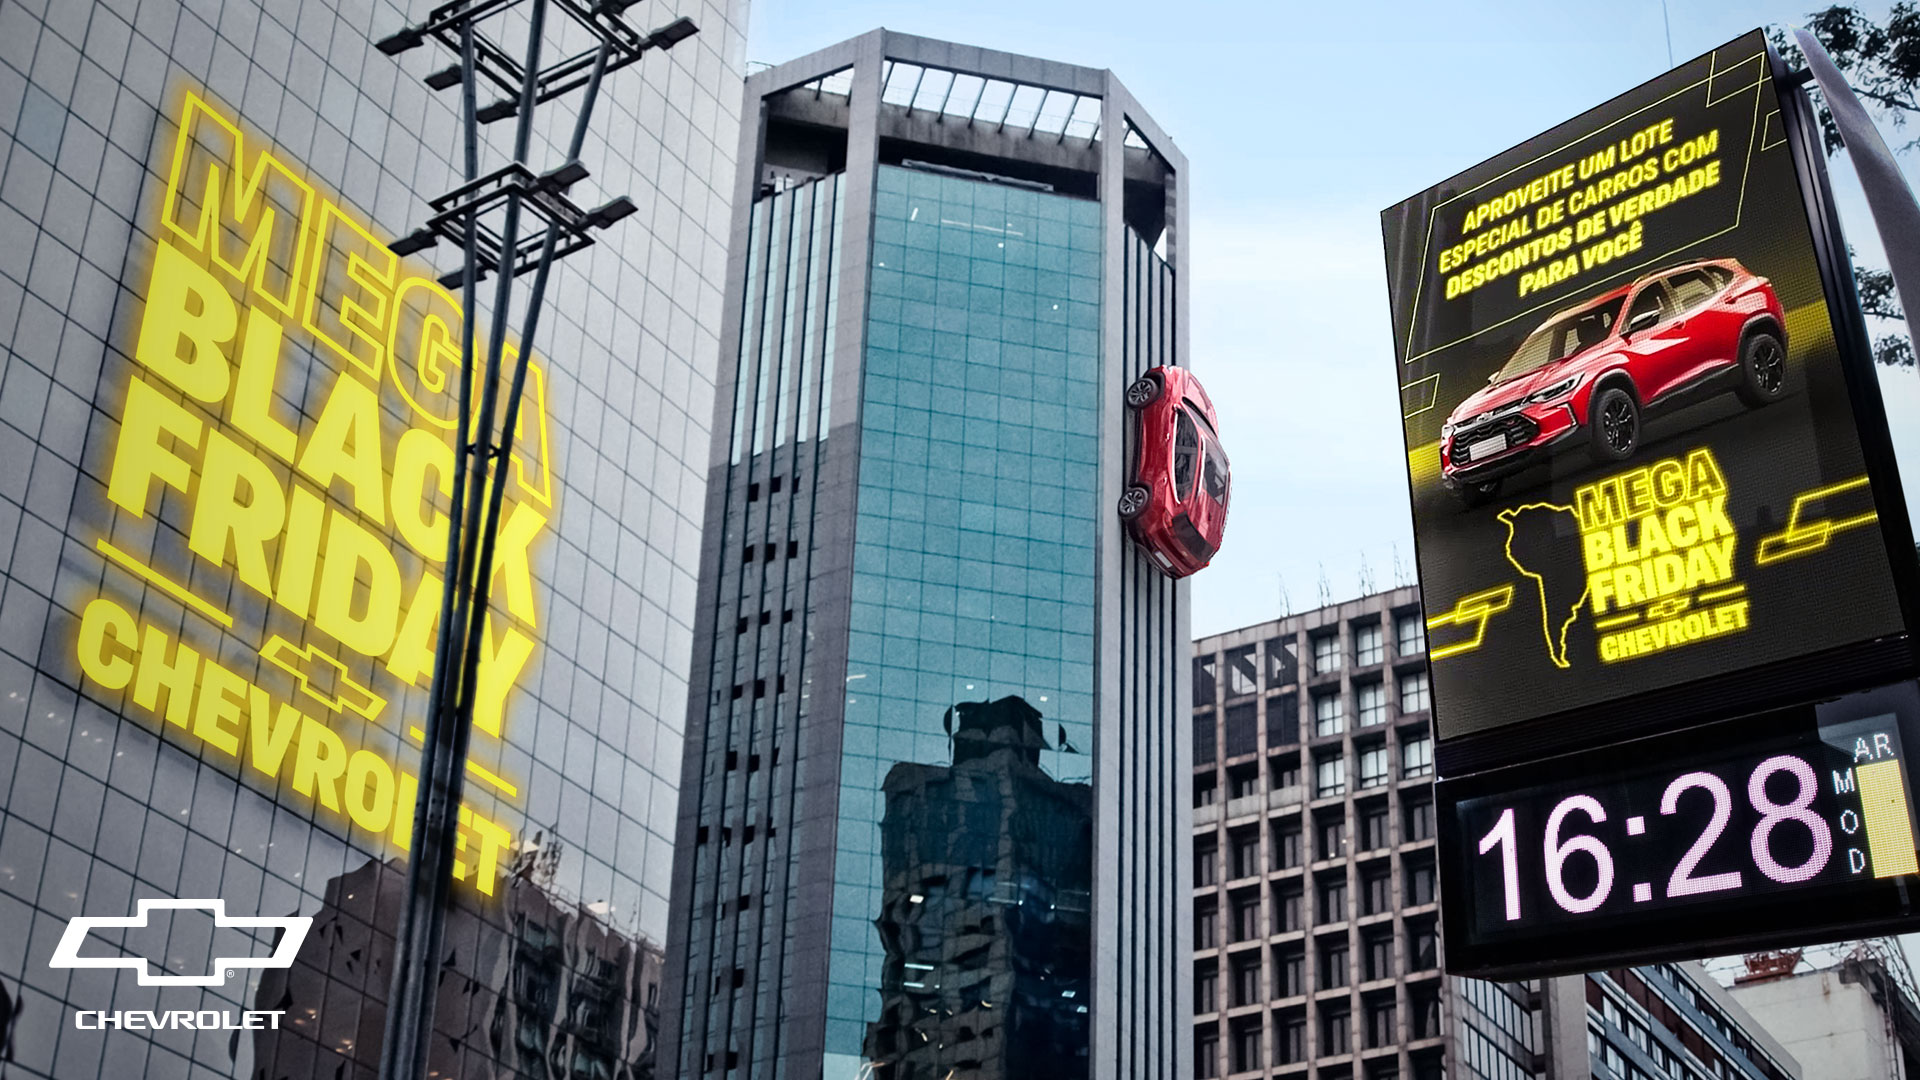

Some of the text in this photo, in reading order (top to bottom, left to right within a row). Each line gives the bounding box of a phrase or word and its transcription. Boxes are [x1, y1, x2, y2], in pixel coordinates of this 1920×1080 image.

[1439, 129, 1719, 274] ESPECIAL DE CARROS COM
[1446, 160, 1721, 300] DESCONTOS DE VERDADE
[1462, 118, 1674, 235] APROVEITE UM LOTE
[161, 91, 552, 508] MEGA
[1519, 220, 1643, 297] PARA VOCÊ
[136, 238, 547, 628] BLACK
[1576, 449, 1726, 532] MEGA
[107, 374, 535, 738] FRIDAY
[1583, 495, 1734, 573] BLACK
[1588, 535, 1735, 614] FRIDAY
[1600, 601, 1748, 662] CHEVROLET
[1854, 733, 1895, 763] AR
[1478, 755, 1833, 921] 16:28
